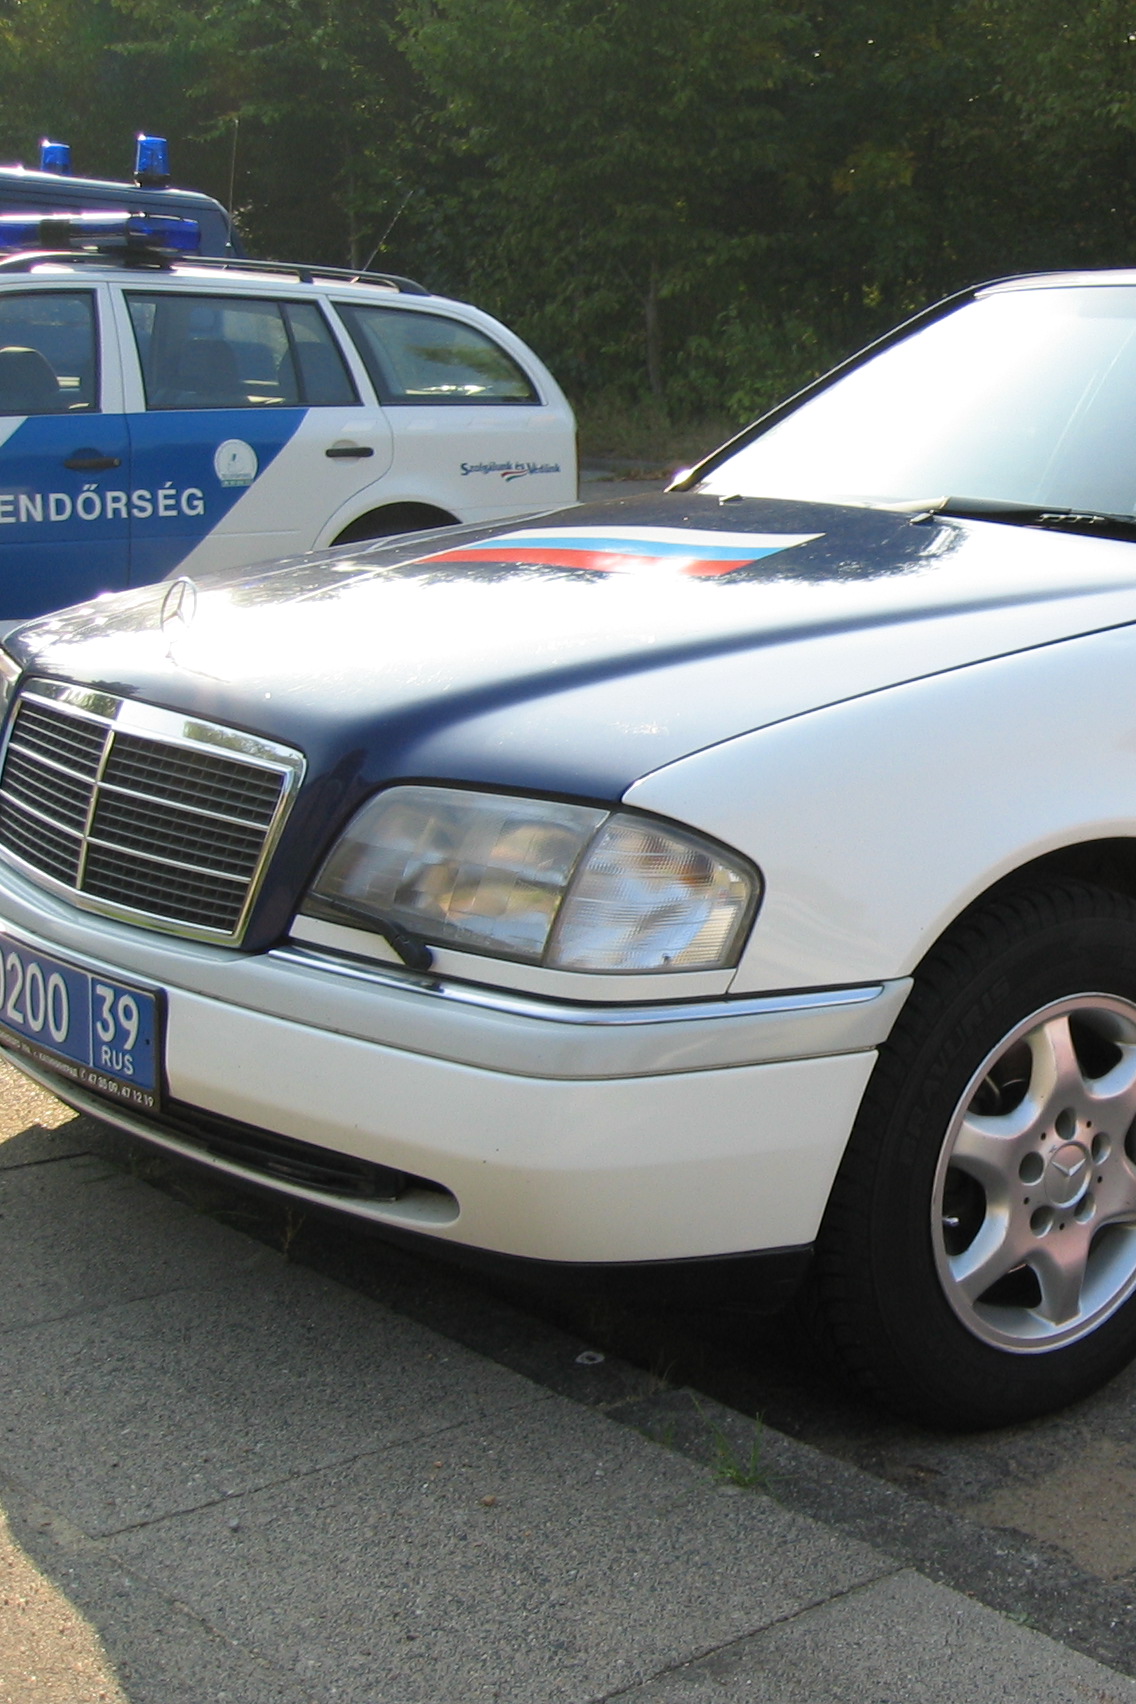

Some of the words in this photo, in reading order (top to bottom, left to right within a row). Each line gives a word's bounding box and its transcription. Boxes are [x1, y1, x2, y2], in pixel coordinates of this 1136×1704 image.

[0, 481, 205, 524] ENDŐRSÉG
[0, 950, 69, 1043] 200
[95, 983, 140, 1051] 39
[101, 1045, 134, 1076] RUS
